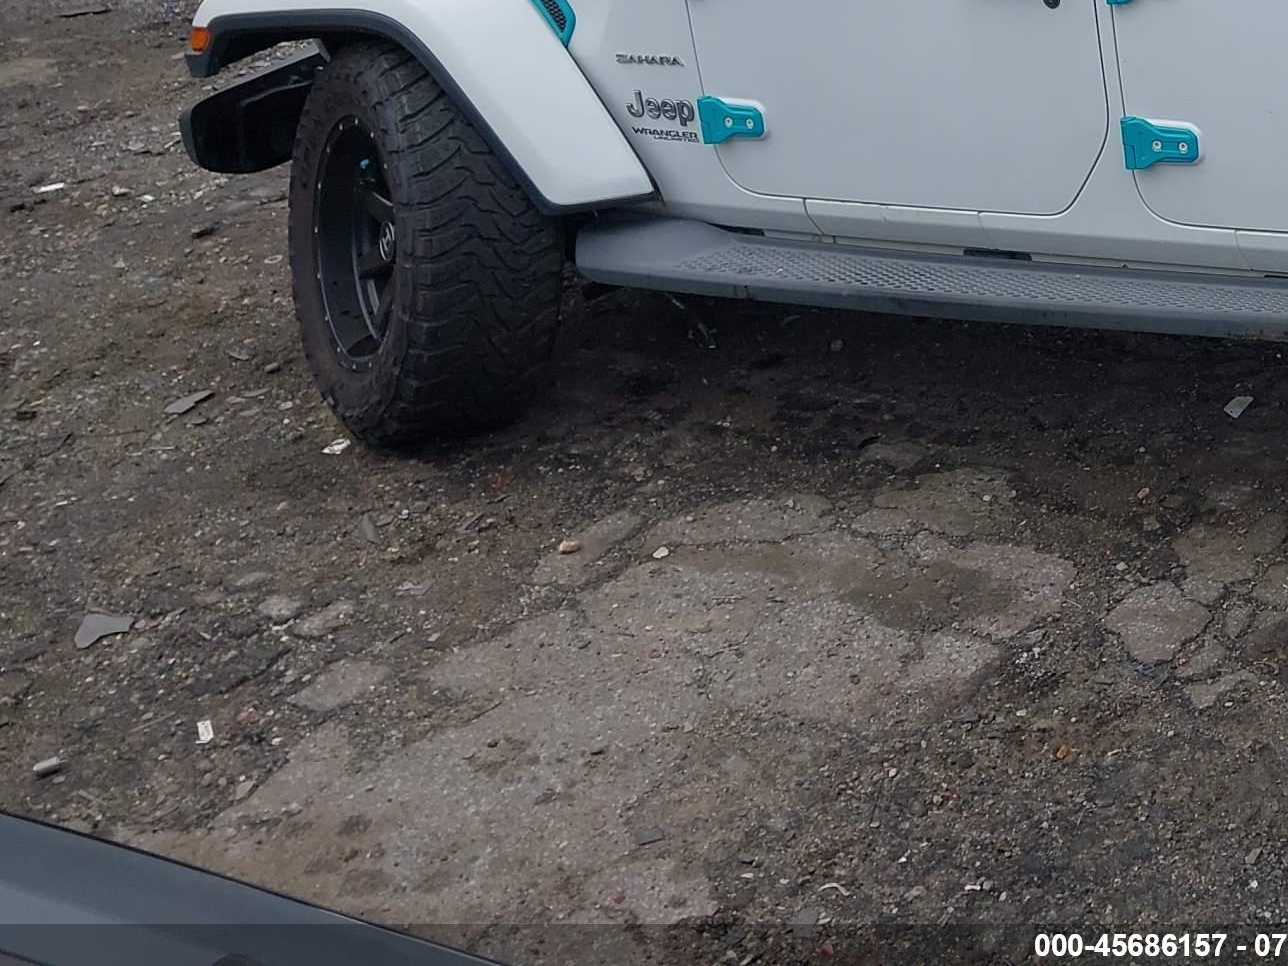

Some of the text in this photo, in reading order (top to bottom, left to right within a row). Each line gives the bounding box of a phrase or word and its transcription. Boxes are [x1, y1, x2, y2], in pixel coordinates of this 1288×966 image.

[615, 54, 685, 67] SAHARA
[626, 90, 695, 126] Jeep
[632, 126, 698, 139] WRANGLER
